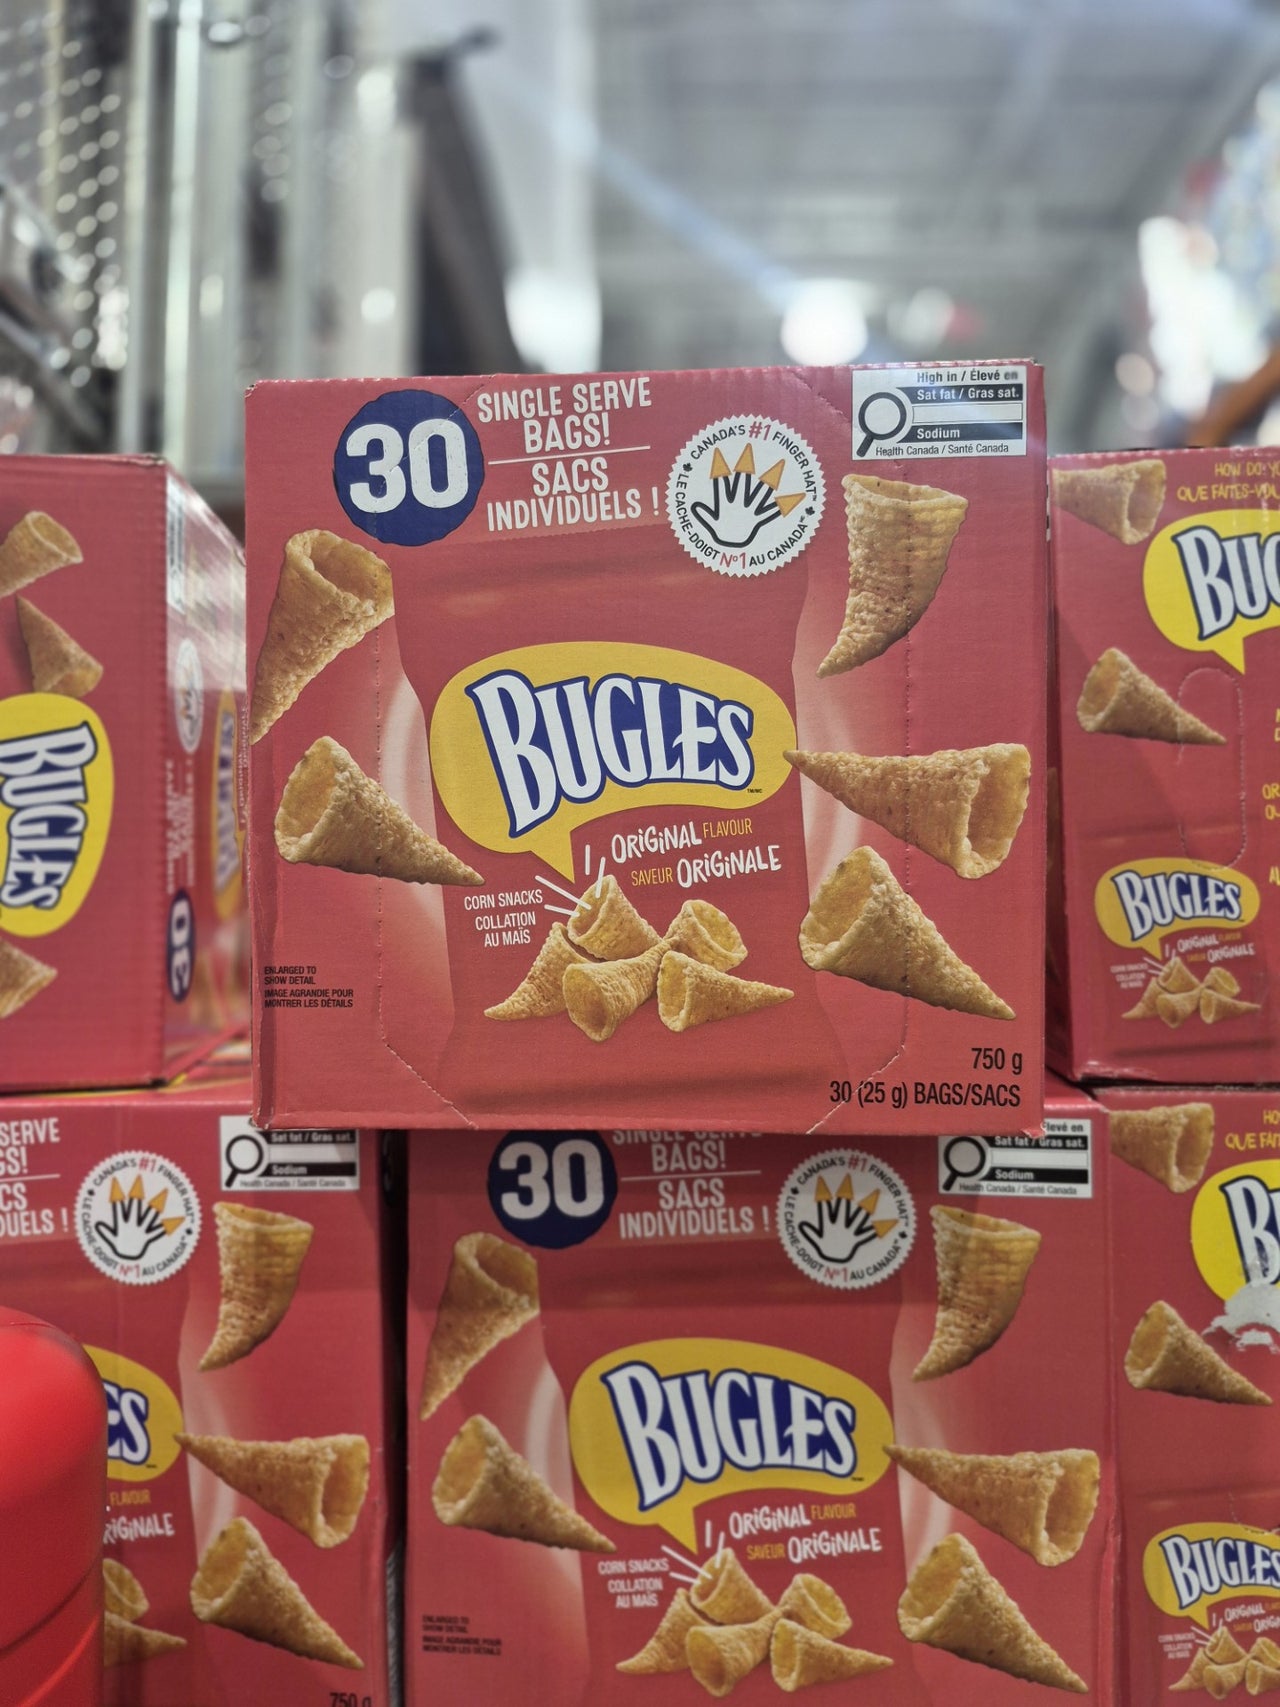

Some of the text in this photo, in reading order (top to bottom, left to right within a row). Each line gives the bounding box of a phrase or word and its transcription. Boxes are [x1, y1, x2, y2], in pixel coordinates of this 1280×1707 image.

[917, 372, 943, 385] High
[947, 371, 958, 382] in
[970, 369, 1000, 381] Élevé
[477, 377, 652, 423] SINGLE SERVE
[917, 389, 937, 400] Sat
[940, 388, 956, 400] fat
[967, 387, 994, 399] Gras
[997, 387, 1020, 398] sat.
[523, 411, 610, 454] BAGS!
[916, 428, 961, 440] Sodium
[690, 424, 746, 460] CANADA'S
[748, 421, 772, 441] #1
[772, 431, 809, 470] FINGER
[875, 446, 904, 457] Health
[906, 445, 939, 456] Canada
[947, 443, 973, 454] Santé
[976, 443, 1009, 453] Canada
[346, 418, 469, 514] 30
[531, 456, 609, 497] SACS
[676, 473, 689, 490] LE
[487, 487, 642, 532] INDIVIDUELS
[675, 491, 721, 560] CACHE-DOIGT
[749, 554, 766, 567] AU
[464, 668, 754, 838] BUGLES
[0, 720, 98, 911] BUGLES
[702, 817, 753, 839] FLAVOUR
[630, 867, 673, 887] SAVEUR
[464, 888, 543, 911] CORN SNACKS
[1111, 869, 1242, 942] BUGLES
[474, 911, 536, 931] COLLATION
[483, 927, 531, 948] AU MAÏS
[264, 966, 317, 975] ENLARGED TO
[264, 976, 316, 985] SHOW DETAIL
[264, 989, 288, 998] IMAGE
[331, 989, 354, 998] POUR
[264, 999, 301, 1008] MONTRER
[304, 999, 319, 1008] LES
[971, 1047, 1023, 1075] 750 g
[829, 1080, 1021, 1108] 30 (25 g) BAGS/SACS
[994, 1135, 1012, 1146] Sat
[1014, 1136, 1030, 1146] fat
[651, 1140, 726, 1173] BAGS!
[271, 1164, 308, 1175] Sodium
[499, 1138, 605, 1221] 30
[797, 1156, 846, 1185] CANADA'S
[848, 1154, 868, 1172] #1
[868, 1163, 902, 1199] FINGER
[995, 1169, 1034, 1180] Sodium
[658, 1177, 726, 1211] SACS
[619, 1206, 754, 1240] INDIVIDUELS
[785, 1196, 796, 1210] LE
[850, 1269, 865, 1280] AU
[599, 1360, 857, 1512] BUGLES
[811, 1503, 856, 1520] FLAVOUR
[746, 1544, 785, 1561] SAVEUR
[597, 1557, 669, 1575] CORN SNACKS
[607, 1578, 663, 1594] COLLATION
[615, 1595, 630, 1609] AU
